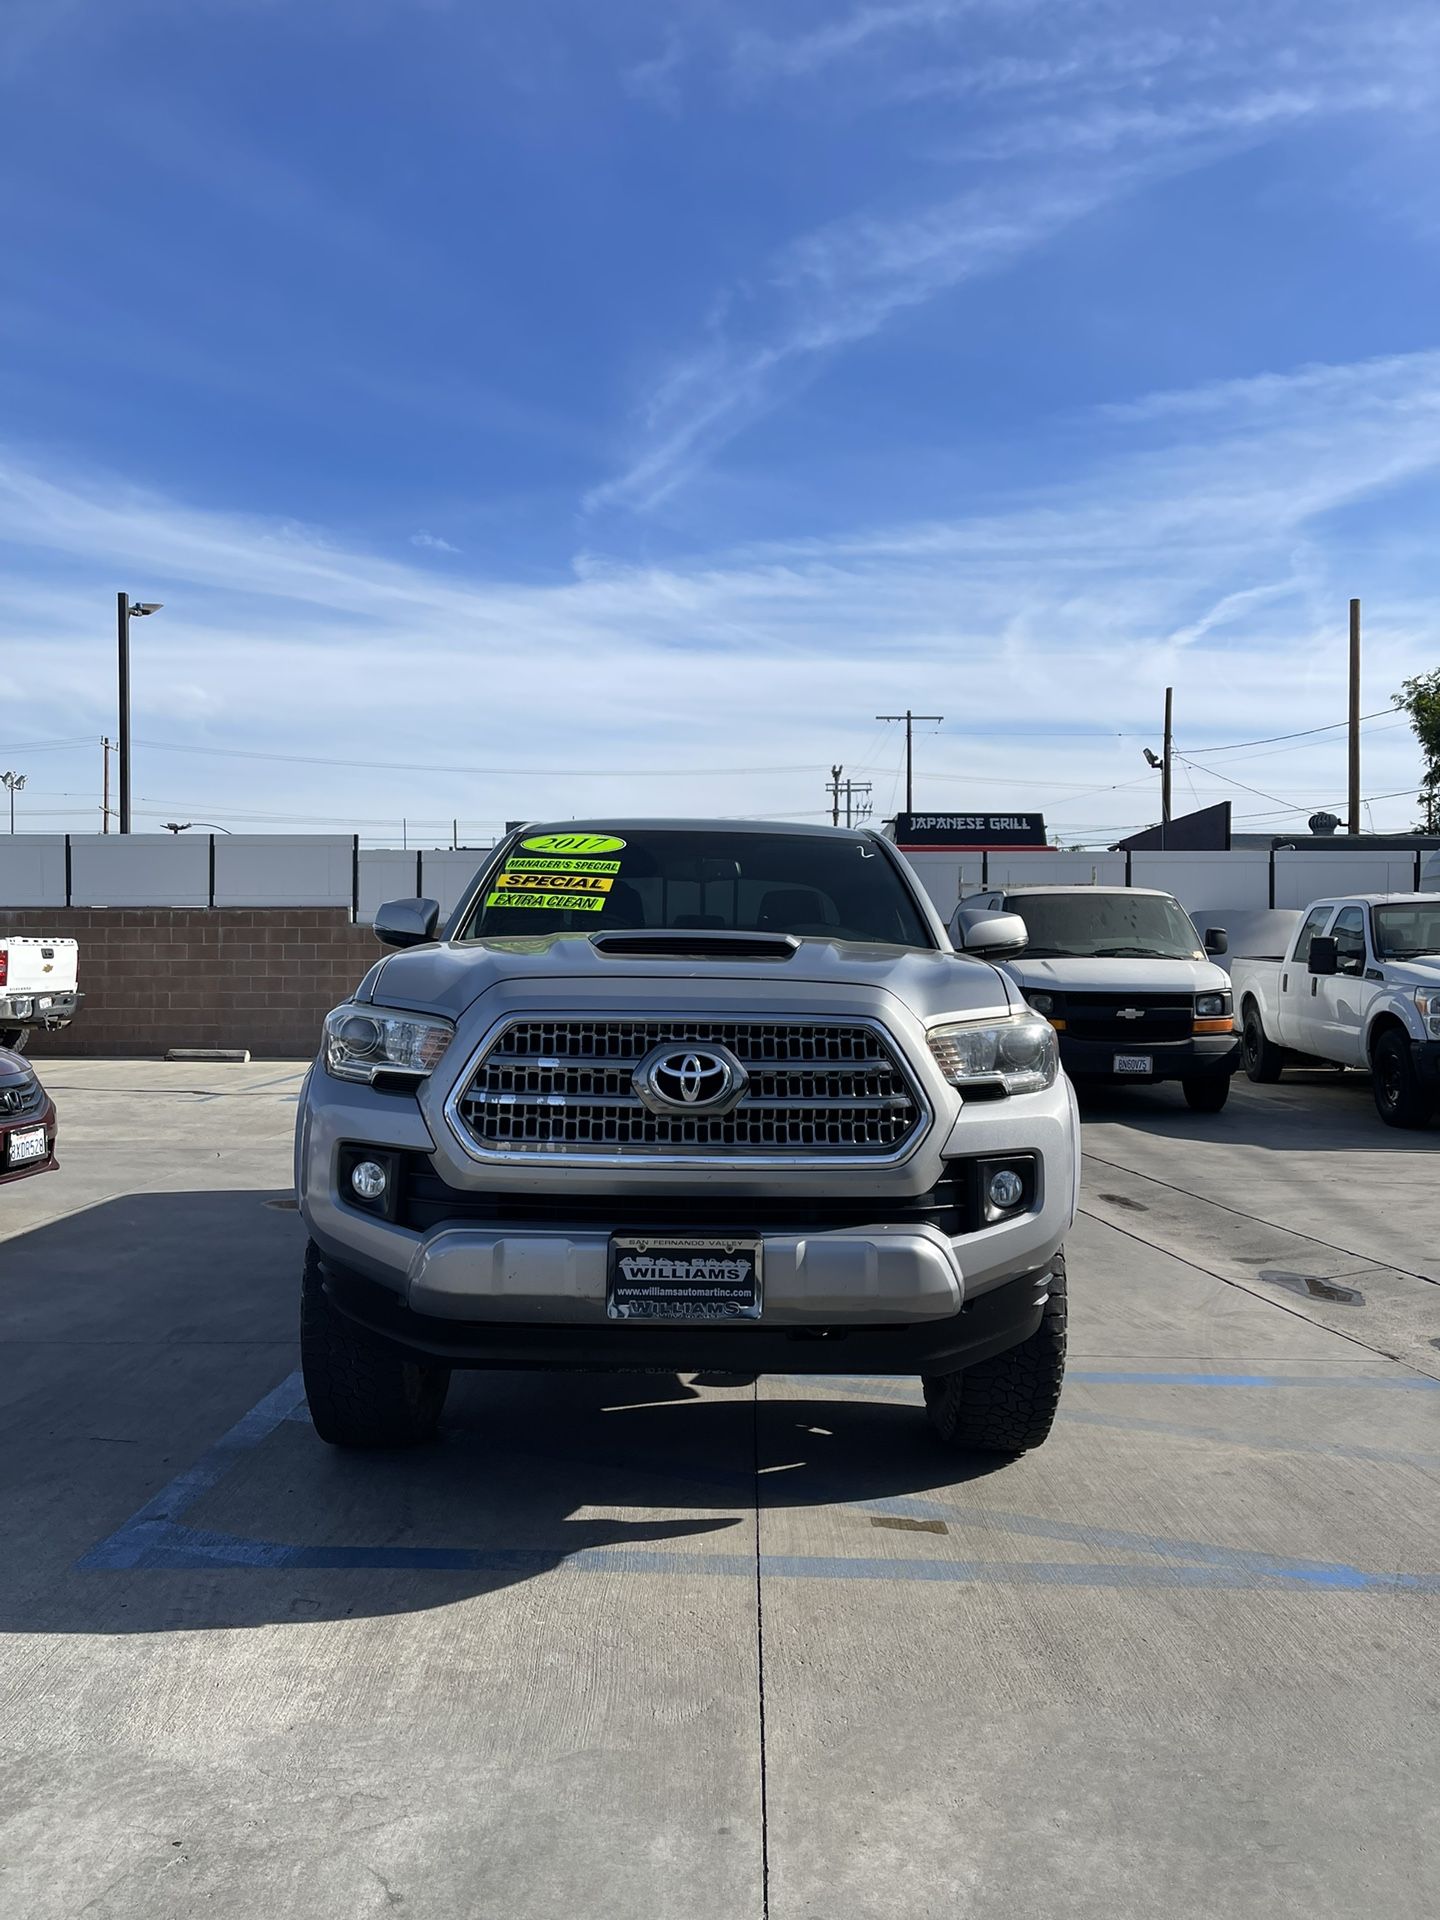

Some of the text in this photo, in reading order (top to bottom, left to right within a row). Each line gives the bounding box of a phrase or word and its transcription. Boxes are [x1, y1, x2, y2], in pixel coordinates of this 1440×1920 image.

[910, 816, 1031, 831] JAPANESE GRILL
[537, 838, 608, 849] 2017
[507, 860, 617, 871] MANAGER'S SPECIAL
[506, 876, 605, 889] SPECIAL
[494, 894, 598, 909] EXTRA CLEAN
[629, 1267, 740, 1279] WILLIAMS
[617, 1287, 752, 1297] www.williamsautomartinc.com
[628, 1300, 740, 1314] WILLIAMS
